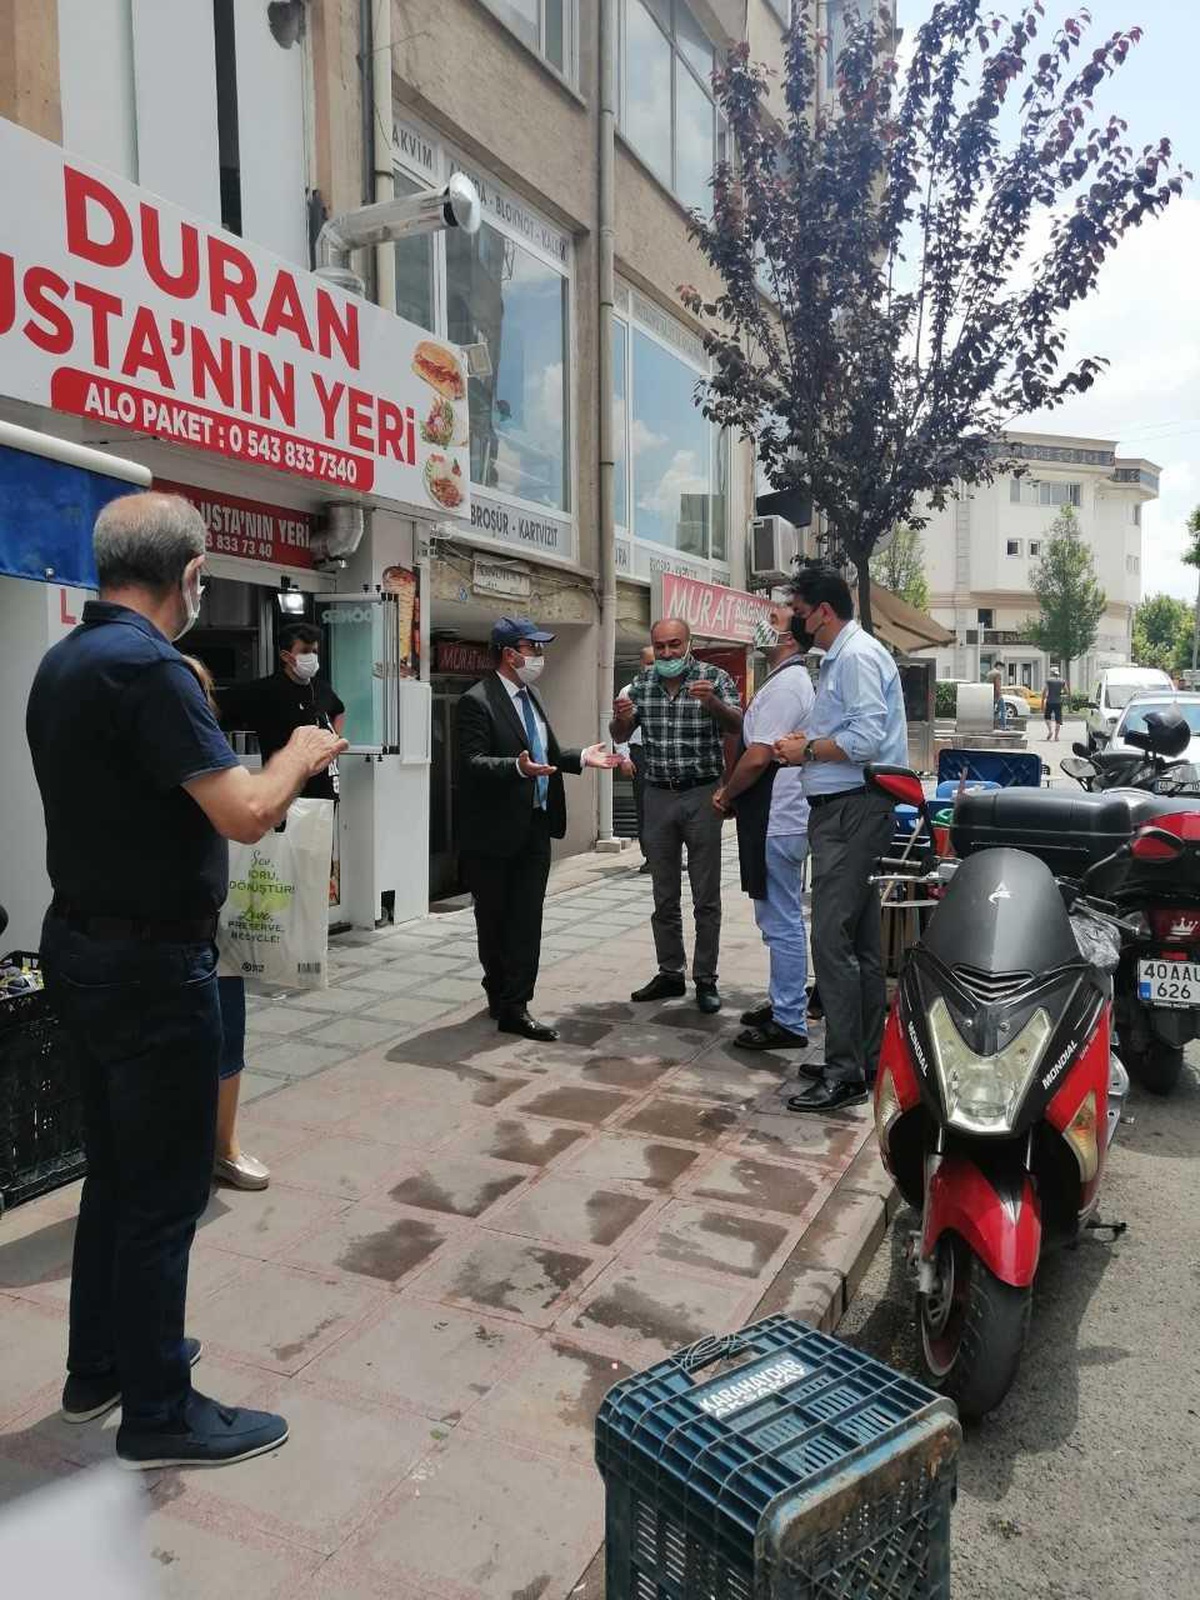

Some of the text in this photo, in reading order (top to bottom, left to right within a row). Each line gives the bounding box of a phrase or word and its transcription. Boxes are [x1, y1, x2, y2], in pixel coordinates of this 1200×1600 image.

[64, 164, 361, 371] DURAN
[84, 382, 136, 424] ALO
[142, 403, 214, 446] PAKET
[229, 424, 242, 453] 0
[248, 434, 282, 465] 543
[285, 442, 315, 473] 833
[318, 450, 358, 484] 7340
[311, 371, 417, 466] YERİ
[215, 533, 239, 552] 833
[258, 541, 273, 558] 40
[470, 503, 509, 537] BROŞÜR
[518, 517, 559, 548] KARTVİZİT
[668, 581, 735, 632] MURAT
[1157, 982, 1191, 999] 626
[1043, 1039, 1079, 1091] MONDIAL
[699, 1359, 803, 1413] KARAHAYDAR
